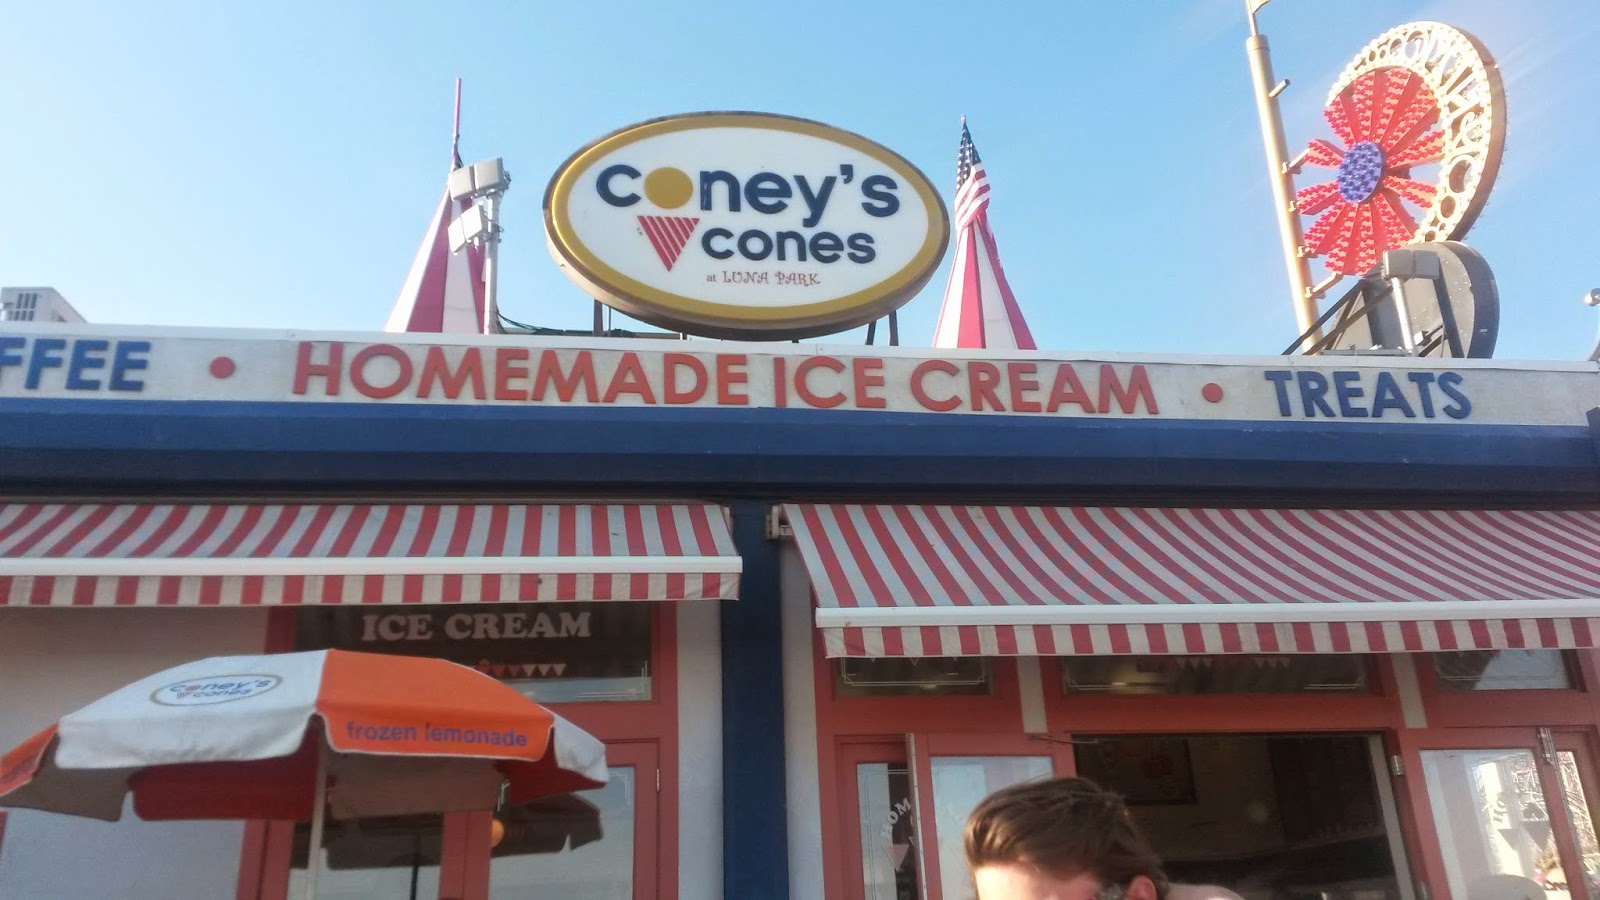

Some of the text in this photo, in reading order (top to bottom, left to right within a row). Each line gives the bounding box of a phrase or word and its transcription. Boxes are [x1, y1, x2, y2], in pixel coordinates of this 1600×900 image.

[701, 228, 876, 264] cones
[706, 271, 821, 287] at LUNA PARK
[293, 341, 1160, 415] HOMEMADE ICE CREAM
[1264, 370, 1472, 420] TREATS
[361, 611, 592, 642] ICE CREAM
[192, 688, 253, 698] cones
[346, 721, 528, 746] frozen lemonade
